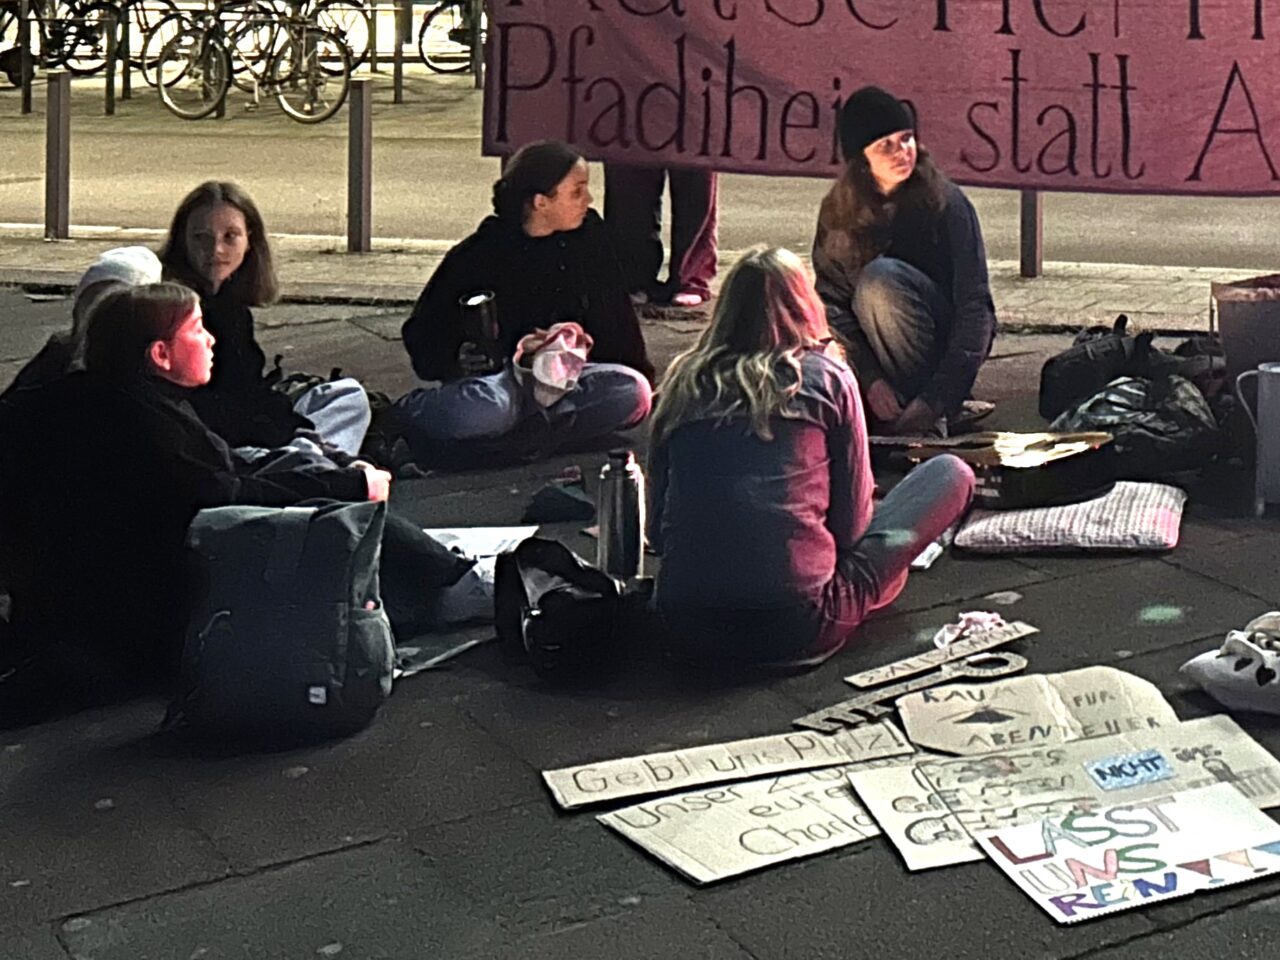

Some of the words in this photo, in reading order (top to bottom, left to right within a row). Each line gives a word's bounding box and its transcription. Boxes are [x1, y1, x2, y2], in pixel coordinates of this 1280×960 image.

[495, 21, 917, 166] Pfadihei
[959, 48, 1147, 180] statt
[988, 795, 1180, 865] LASST
[1019, 843, 1168, 894] UNS
